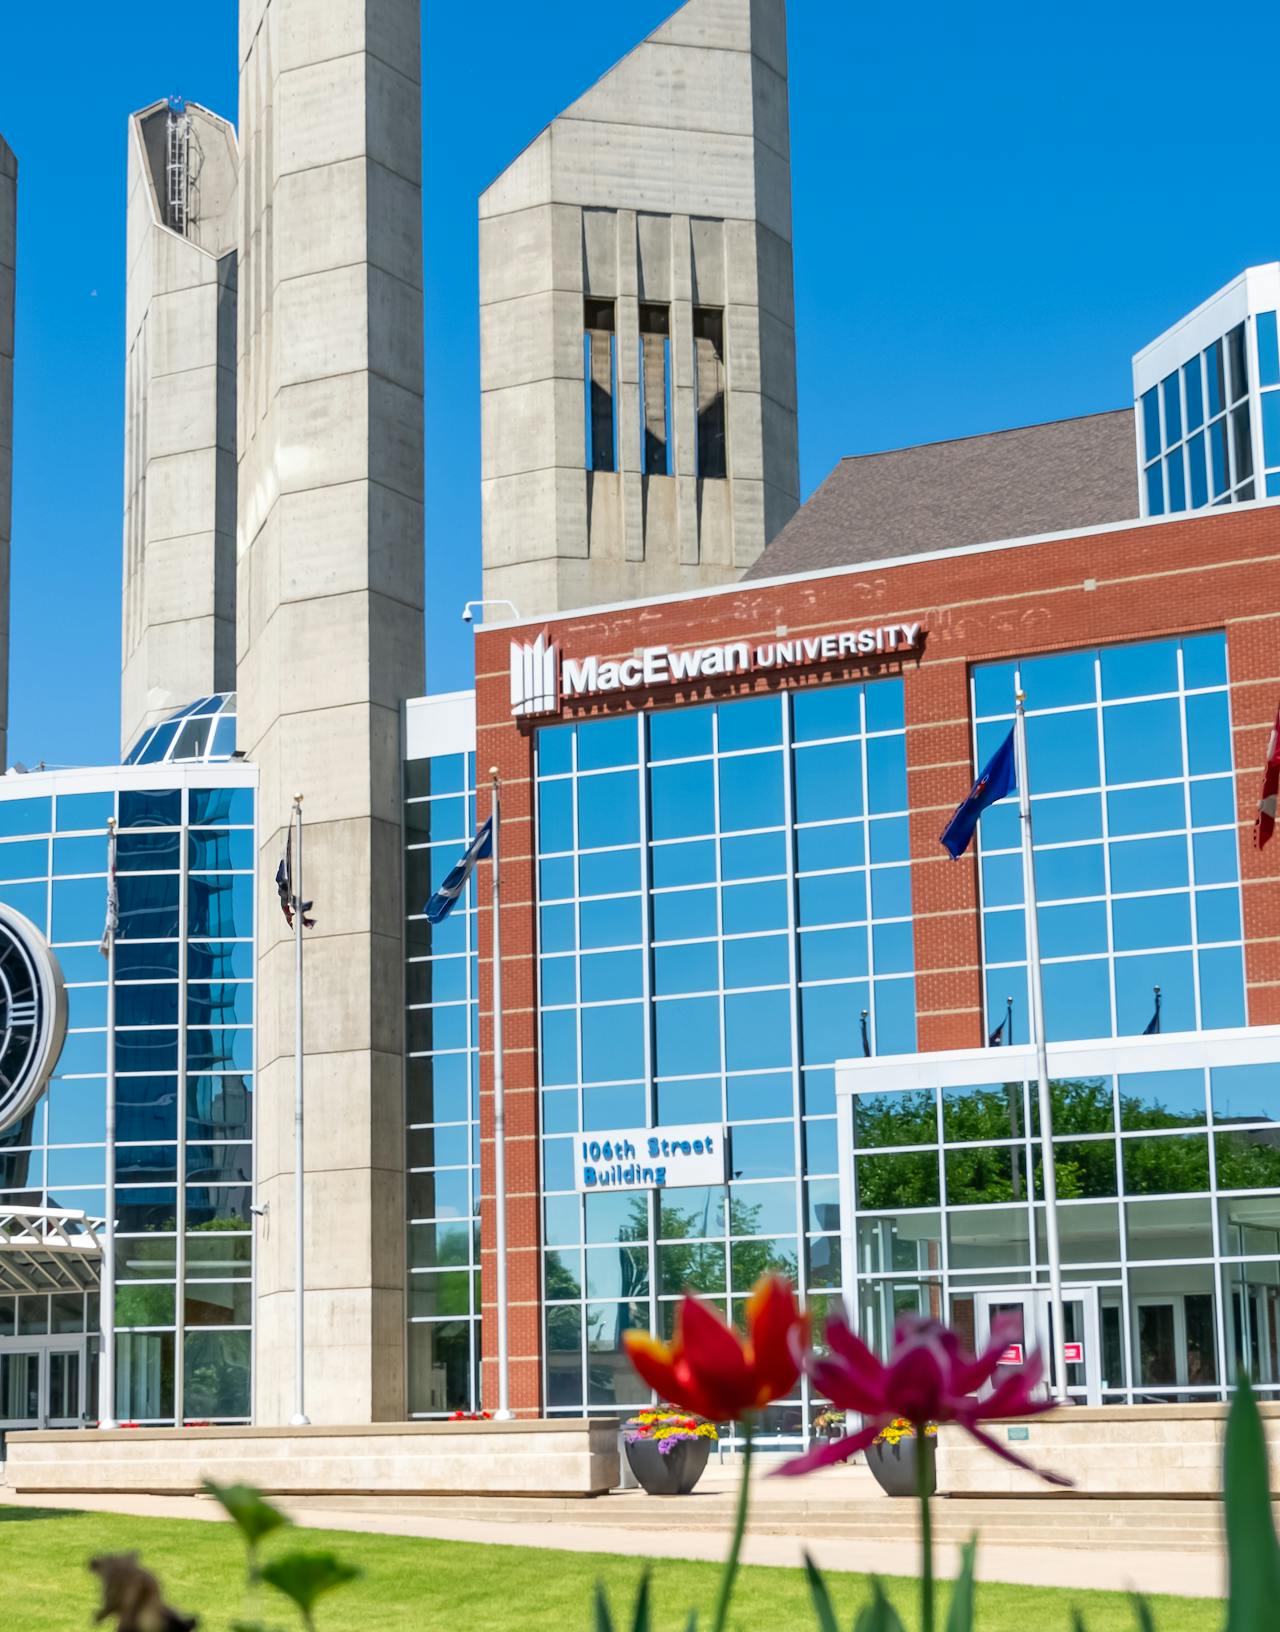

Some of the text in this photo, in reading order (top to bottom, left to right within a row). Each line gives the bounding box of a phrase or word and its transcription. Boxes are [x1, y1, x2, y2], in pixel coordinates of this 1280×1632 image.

[562, 641, 749, 694] MacEwan
[757, 623, 920, 667] UNIVERSITY
[582, 1136, 713, 1161] 106th Street
[583, 1164, 666, 1186] Building
